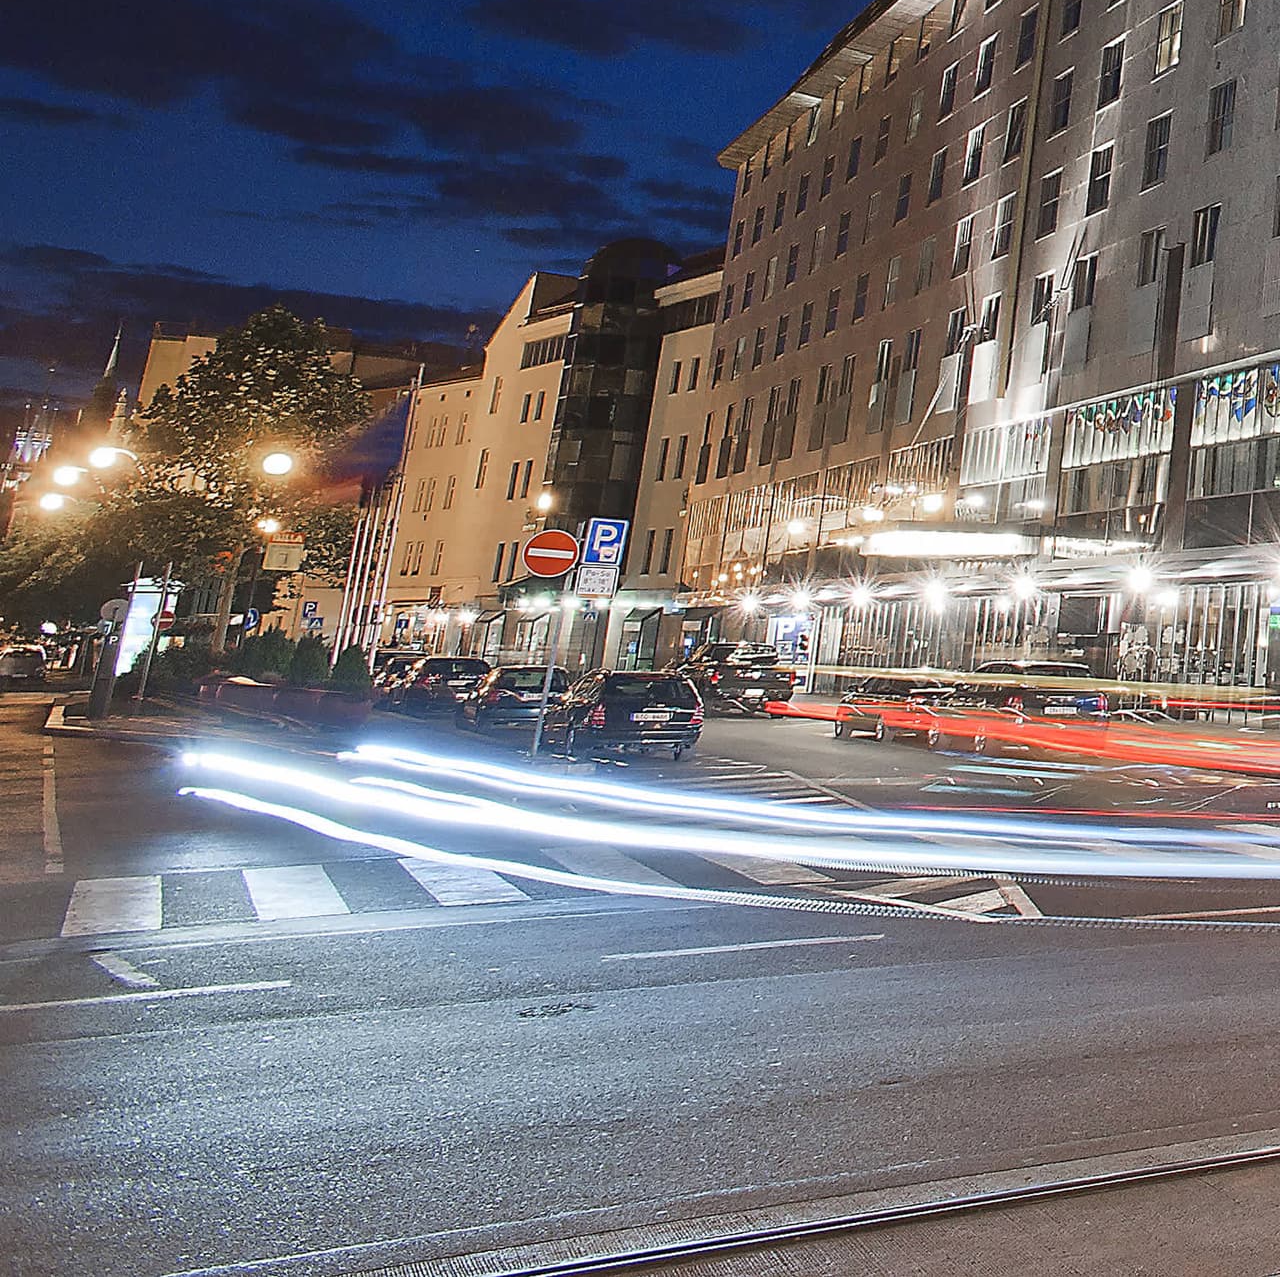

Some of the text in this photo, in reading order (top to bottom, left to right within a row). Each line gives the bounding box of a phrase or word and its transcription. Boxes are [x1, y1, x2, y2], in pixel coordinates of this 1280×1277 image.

[593, 524, 618, 551] P
[305, 603, 316, 614] P
[776, 618, 796, 641] P
